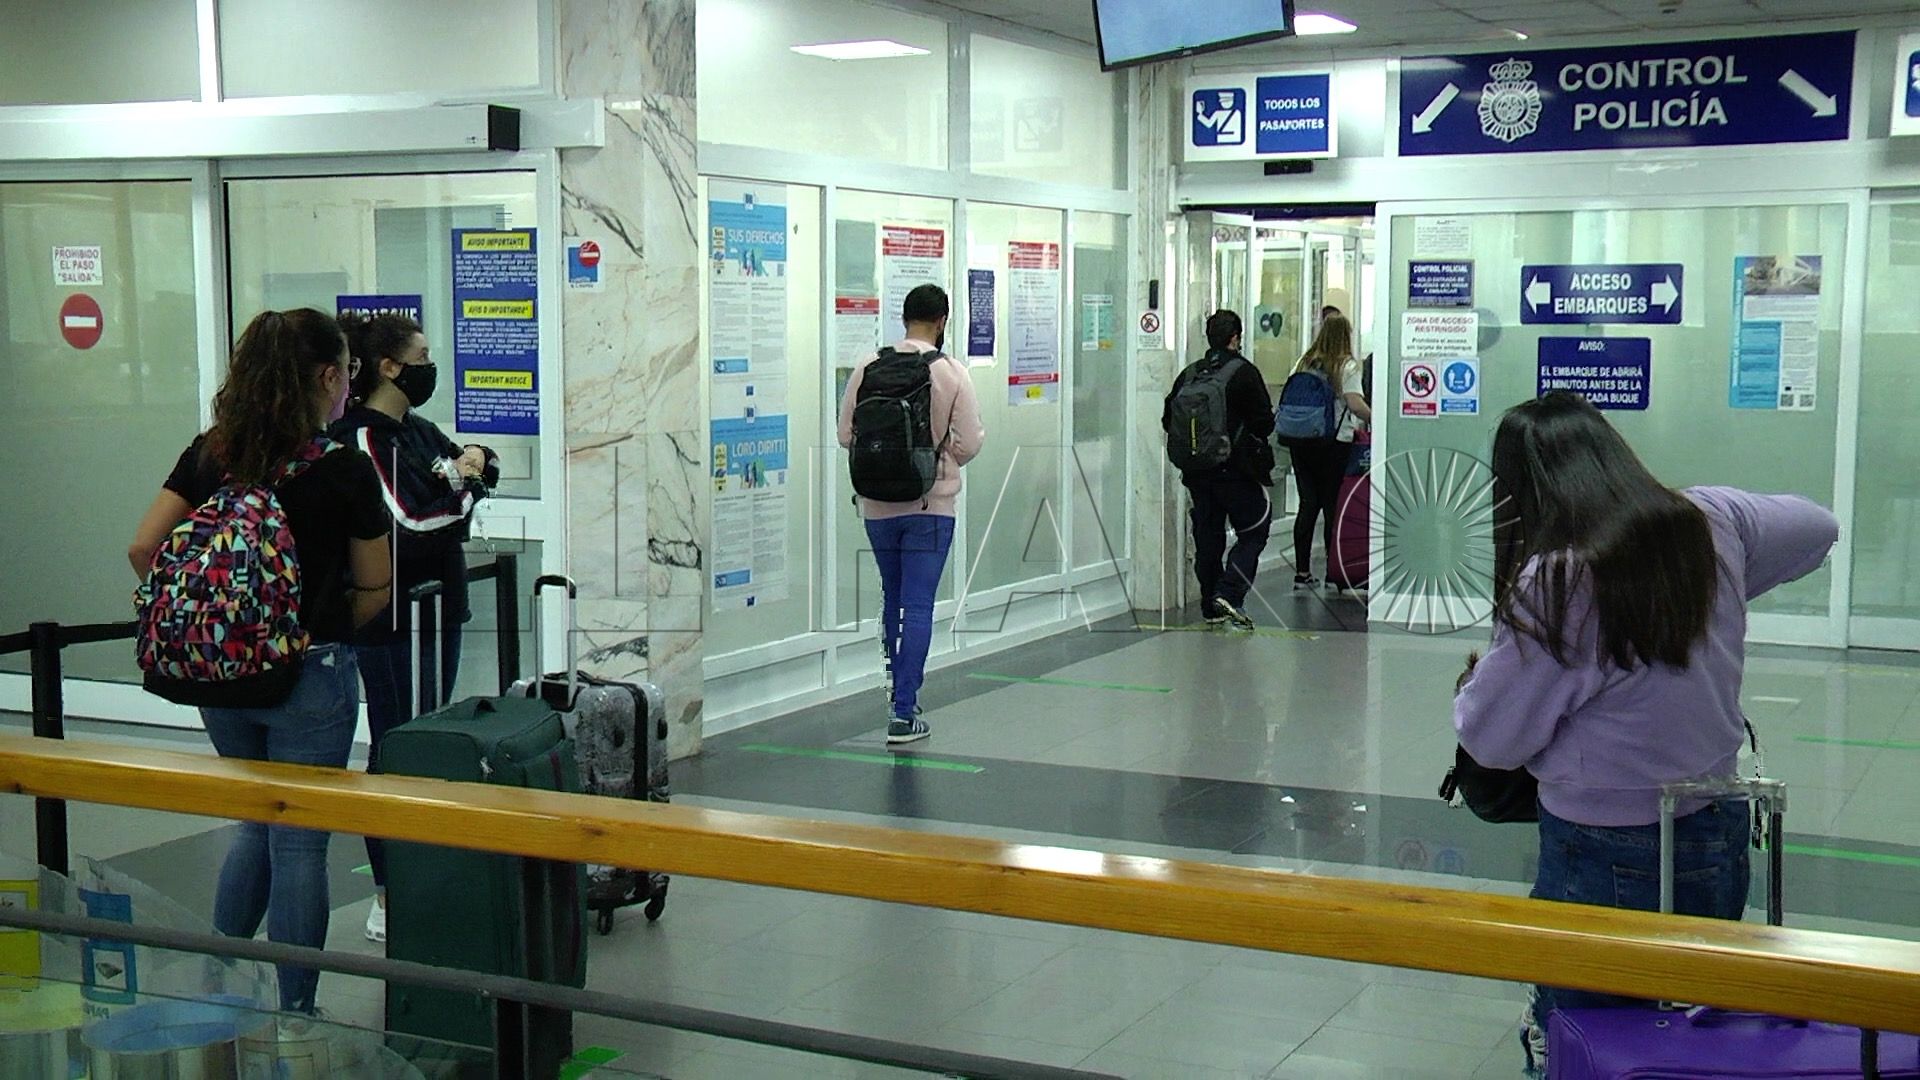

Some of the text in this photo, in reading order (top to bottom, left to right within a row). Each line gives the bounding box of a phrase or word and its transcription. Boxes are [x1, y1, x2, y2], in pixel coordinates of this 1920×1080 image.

[1558, 55, 1748, 92] CONTROL
[1264, 97, 1321, 110] TODOS LOS
[1573, 90, 1729, 132] POLICÍA
[1260, 118, 1325, 131] PASAPORTES
[486, 238, 525, 247] IMPORTANTE
[727, 228, 745, 243] SUS
[746, 229, 785, 245] DERECHOS
[54, 249, 100, 259] PROHIBIDO
[60, 260, 95, 270] EL PASO
[1413, 265, 1468, 273] CONTROL POLICIAL
[1569, 272, 1632, 291] ACCESO
[1554, 297, 1648, 315] EMBARQUES
[1407, 317, 1428, 325] ZONA
[1440, 316, 1474, 324] ACCESO
[1578, 341, 1606, 351] AVISO:
[1541, 366, 1551, 376] EL
[1552, 366, 1599, 377] EMBARQUE
[1612, 365, 1643, 377] ABRIRÁ
[469, 376, 528, 385] IMPORTANT NOTICE
[1541, 379, 1642, 391] 30 MINUTOS ANTES DE LA
[1586, 393, 1609, 403] CADA
[1610, 393, 1639, 404] BUQUE
[757, 438, 786, 456] DIRITTI
